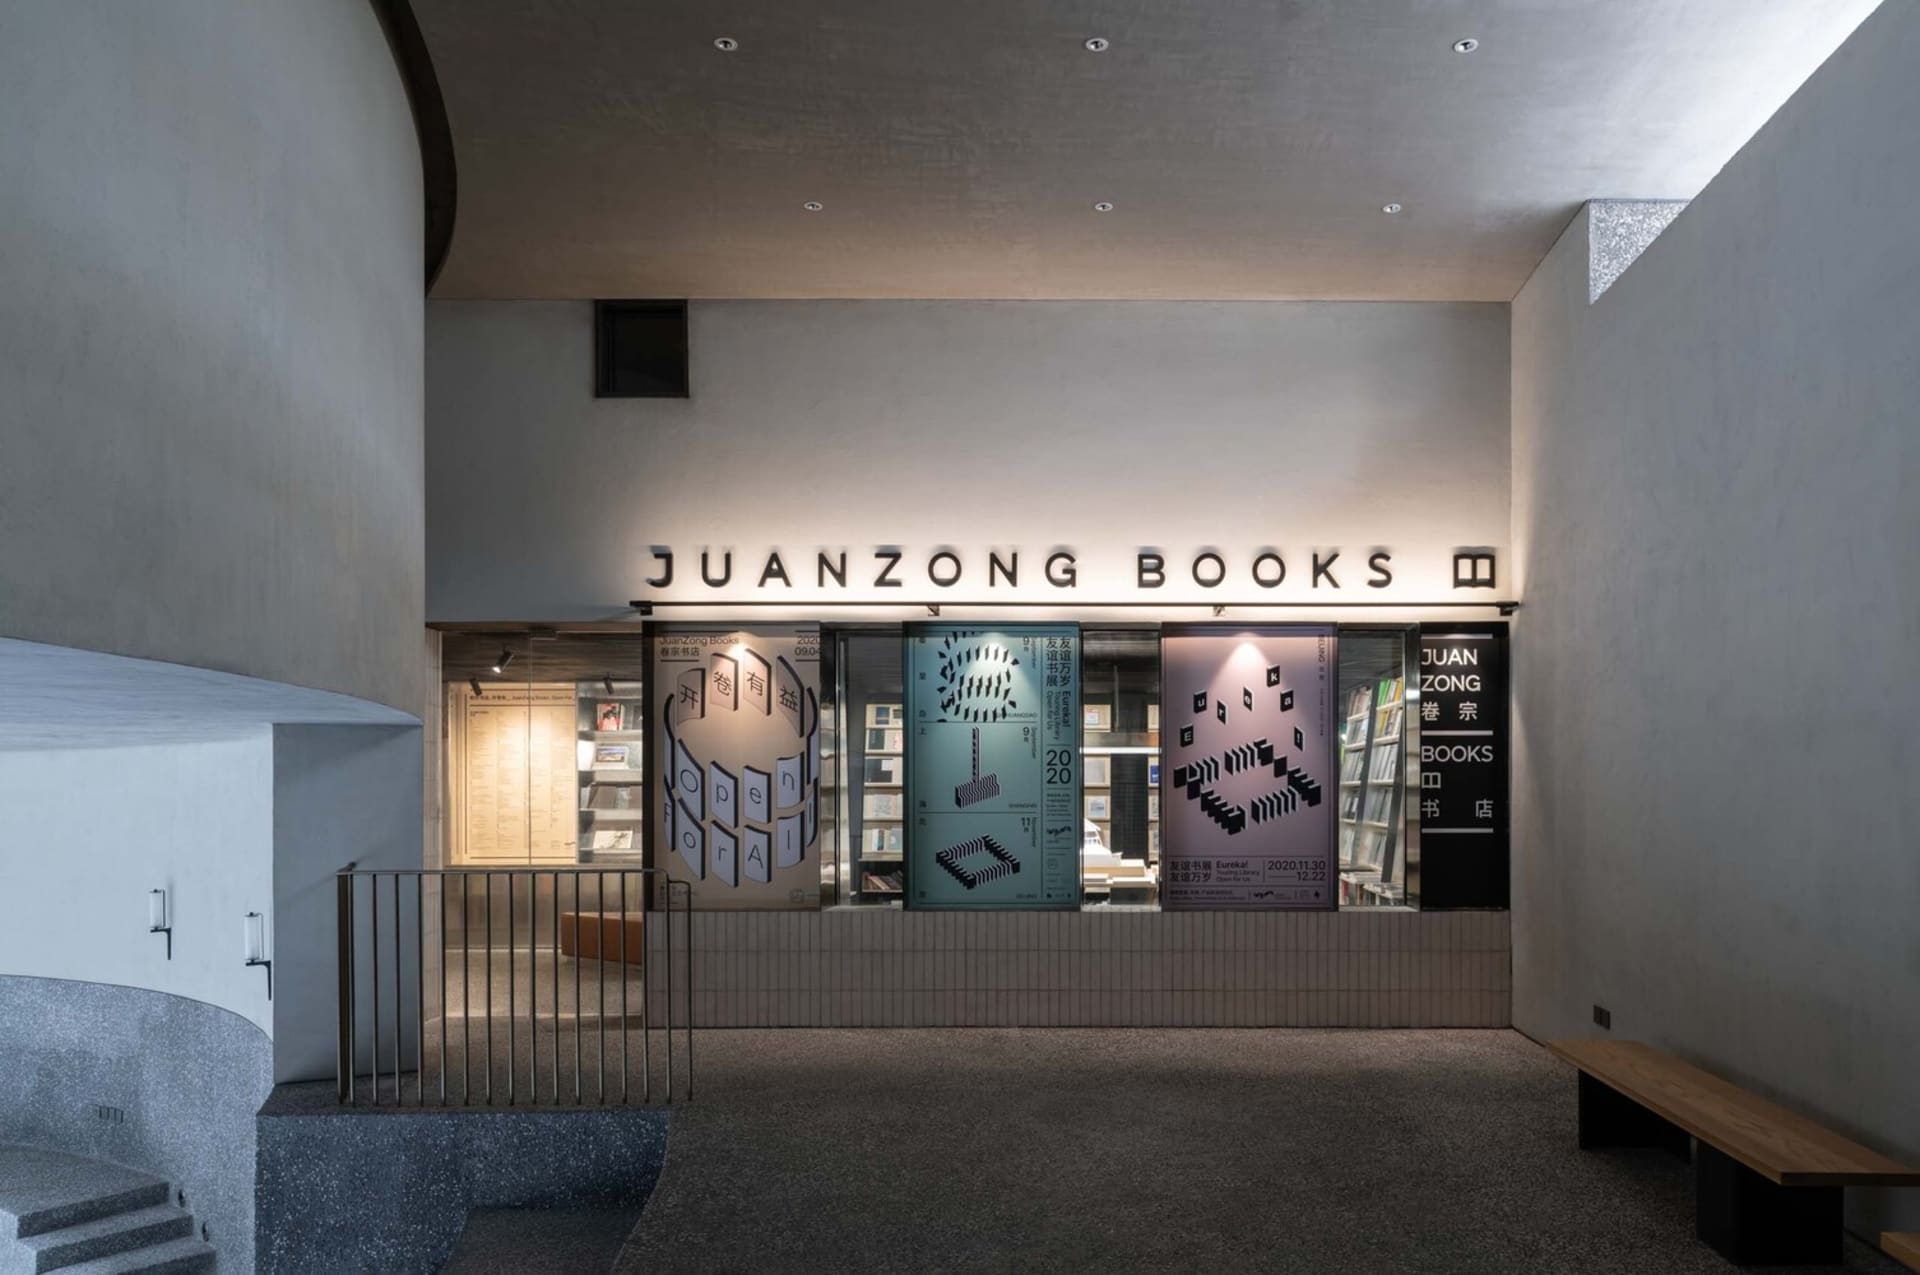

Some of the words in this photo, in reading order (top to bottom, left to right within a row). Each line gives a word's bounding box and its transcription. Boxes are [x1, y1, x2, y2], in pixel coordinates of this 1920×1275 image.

[646, 550, 1077, 588] JUANZONG
[1137, 551, 1393, 589] BOOKS
[660, 636, 707, 647] JuanZong
[709, 636, 739, 645] Books
[661, 648, 699, 656] 卷宗书店
[1421, 648, 1478, 665] JUAN
[1046, 637, 1058, 687] 友谊书展
[1060, 637, 1072, 687] 友谊万岁
[1421, 674, 1481, 692] ZONG
[1046, 749, 1072, 767] 20
[1421, 745, 1494, 762] BOOKS
[1046, 767, 1072, 785] 20
[680, 769, 795, 804] Open
[1170, 860, 1212, 871] 友谊书展
[1216, 860, 1249, 869] Eureka!
[1268, 860, 1326, 871] 2020.11.30
[1170, 871, 1212, 882] 友谊万岁
